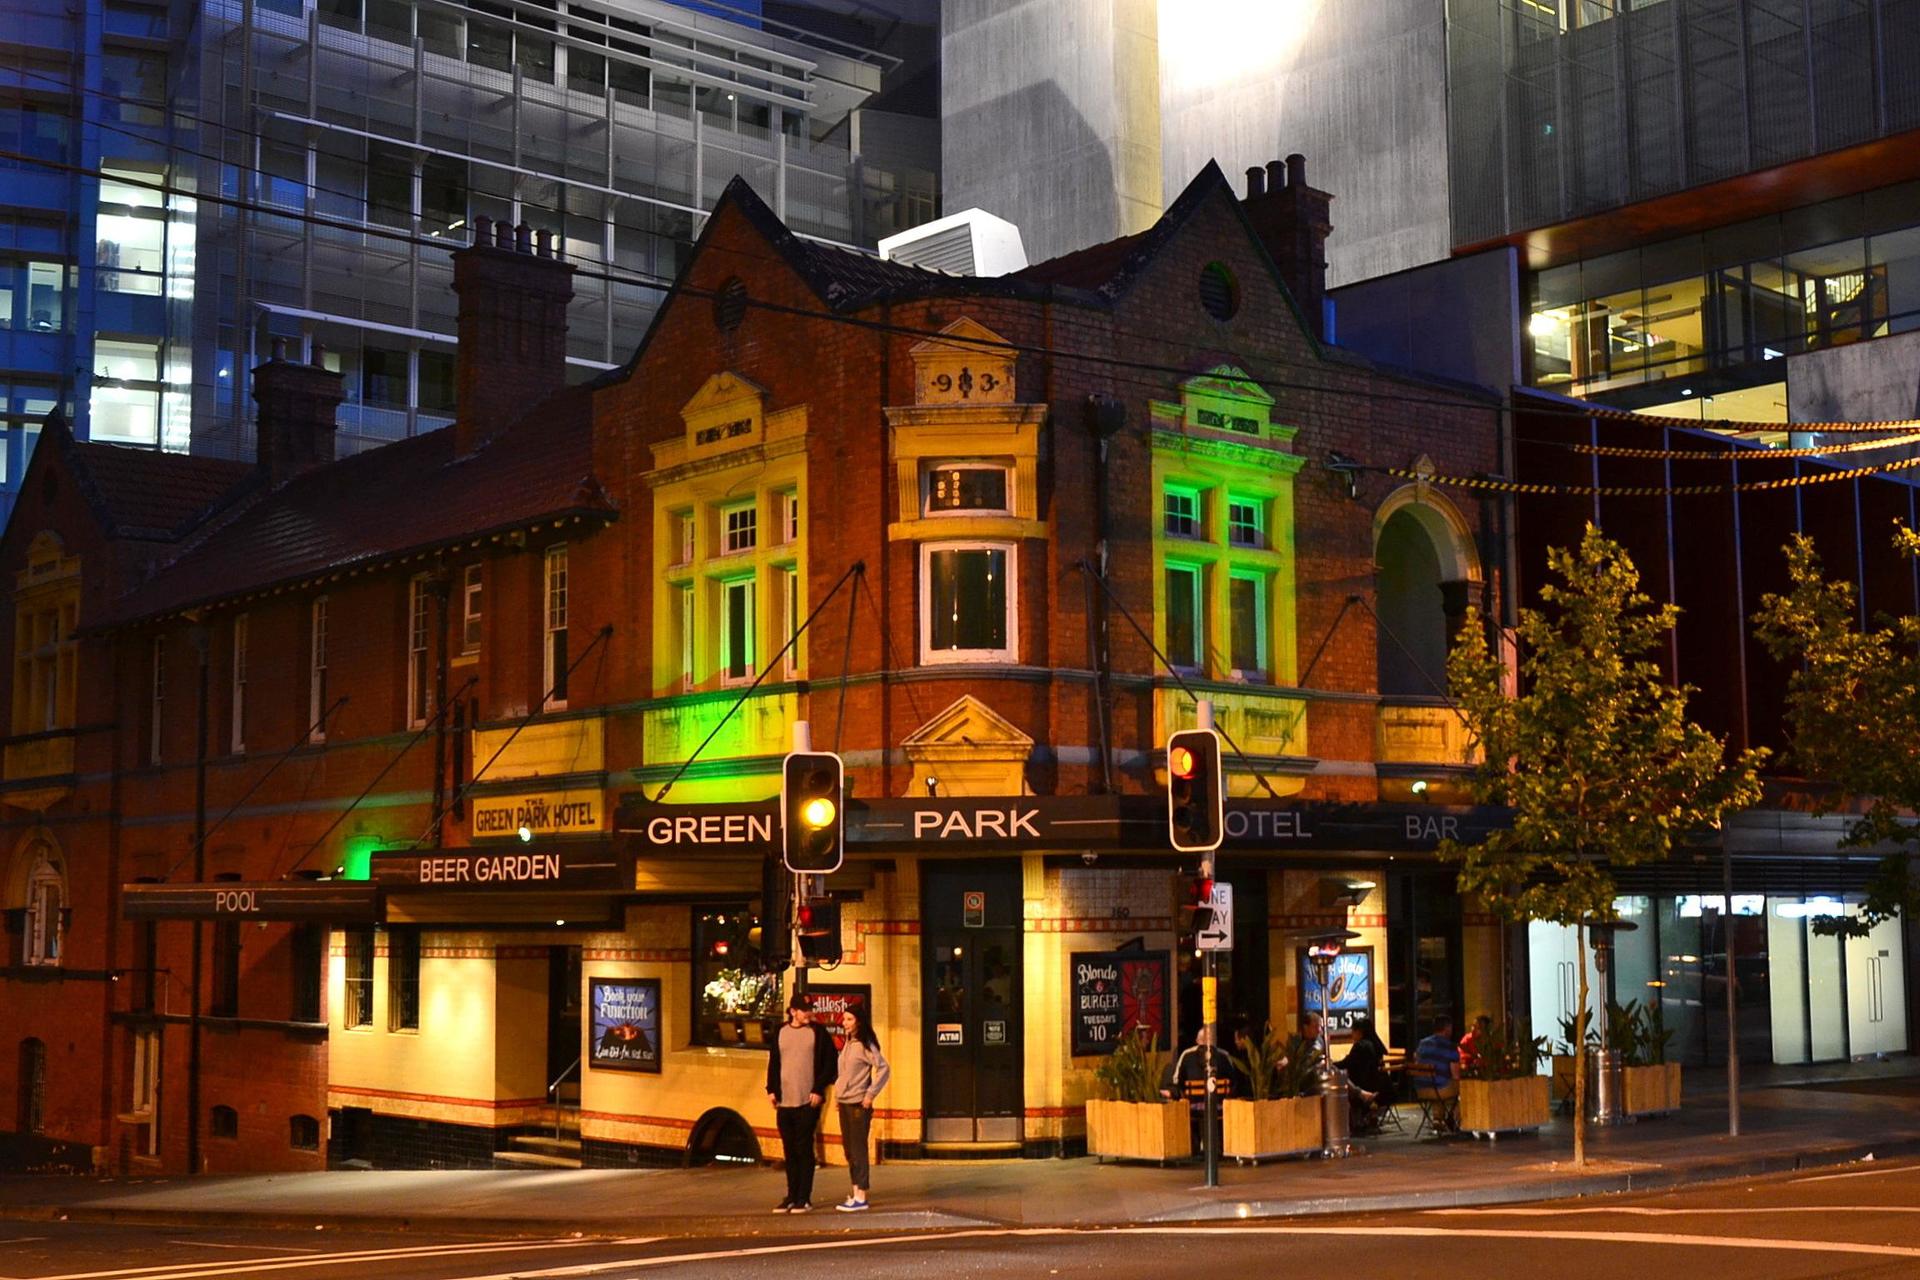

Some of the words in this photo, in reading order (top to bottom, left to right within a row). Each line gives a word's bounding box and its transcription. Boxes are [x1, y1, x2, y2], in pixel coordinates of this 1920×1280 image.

[476, 809, 514, 832] GREEN
[517, 804, 551, 829] PARK
[553, 802, 595, 827] HOTEL
[647, 815, 771, 844] GREEN
[914, 809, 1040, 838] PARK
[1224, 810, 1312, 837] OTEL
[1405, 815, 1460, 839] BAR
[420, 858, 470, 883] BEER
[475, 854, 560, 881] GARDEN
[216, 891, 260, 912] POOL
[1211, 890, 1227, 905] NE
[1211, 910, 1228, 925] AY
[1077, 964, 1117, 985] Blonde
[1081, 994, 1119, 1010] BURGER
[939, 1033, 960, 1042] ATM
[1089, 1025, 1107, 1041] $10
